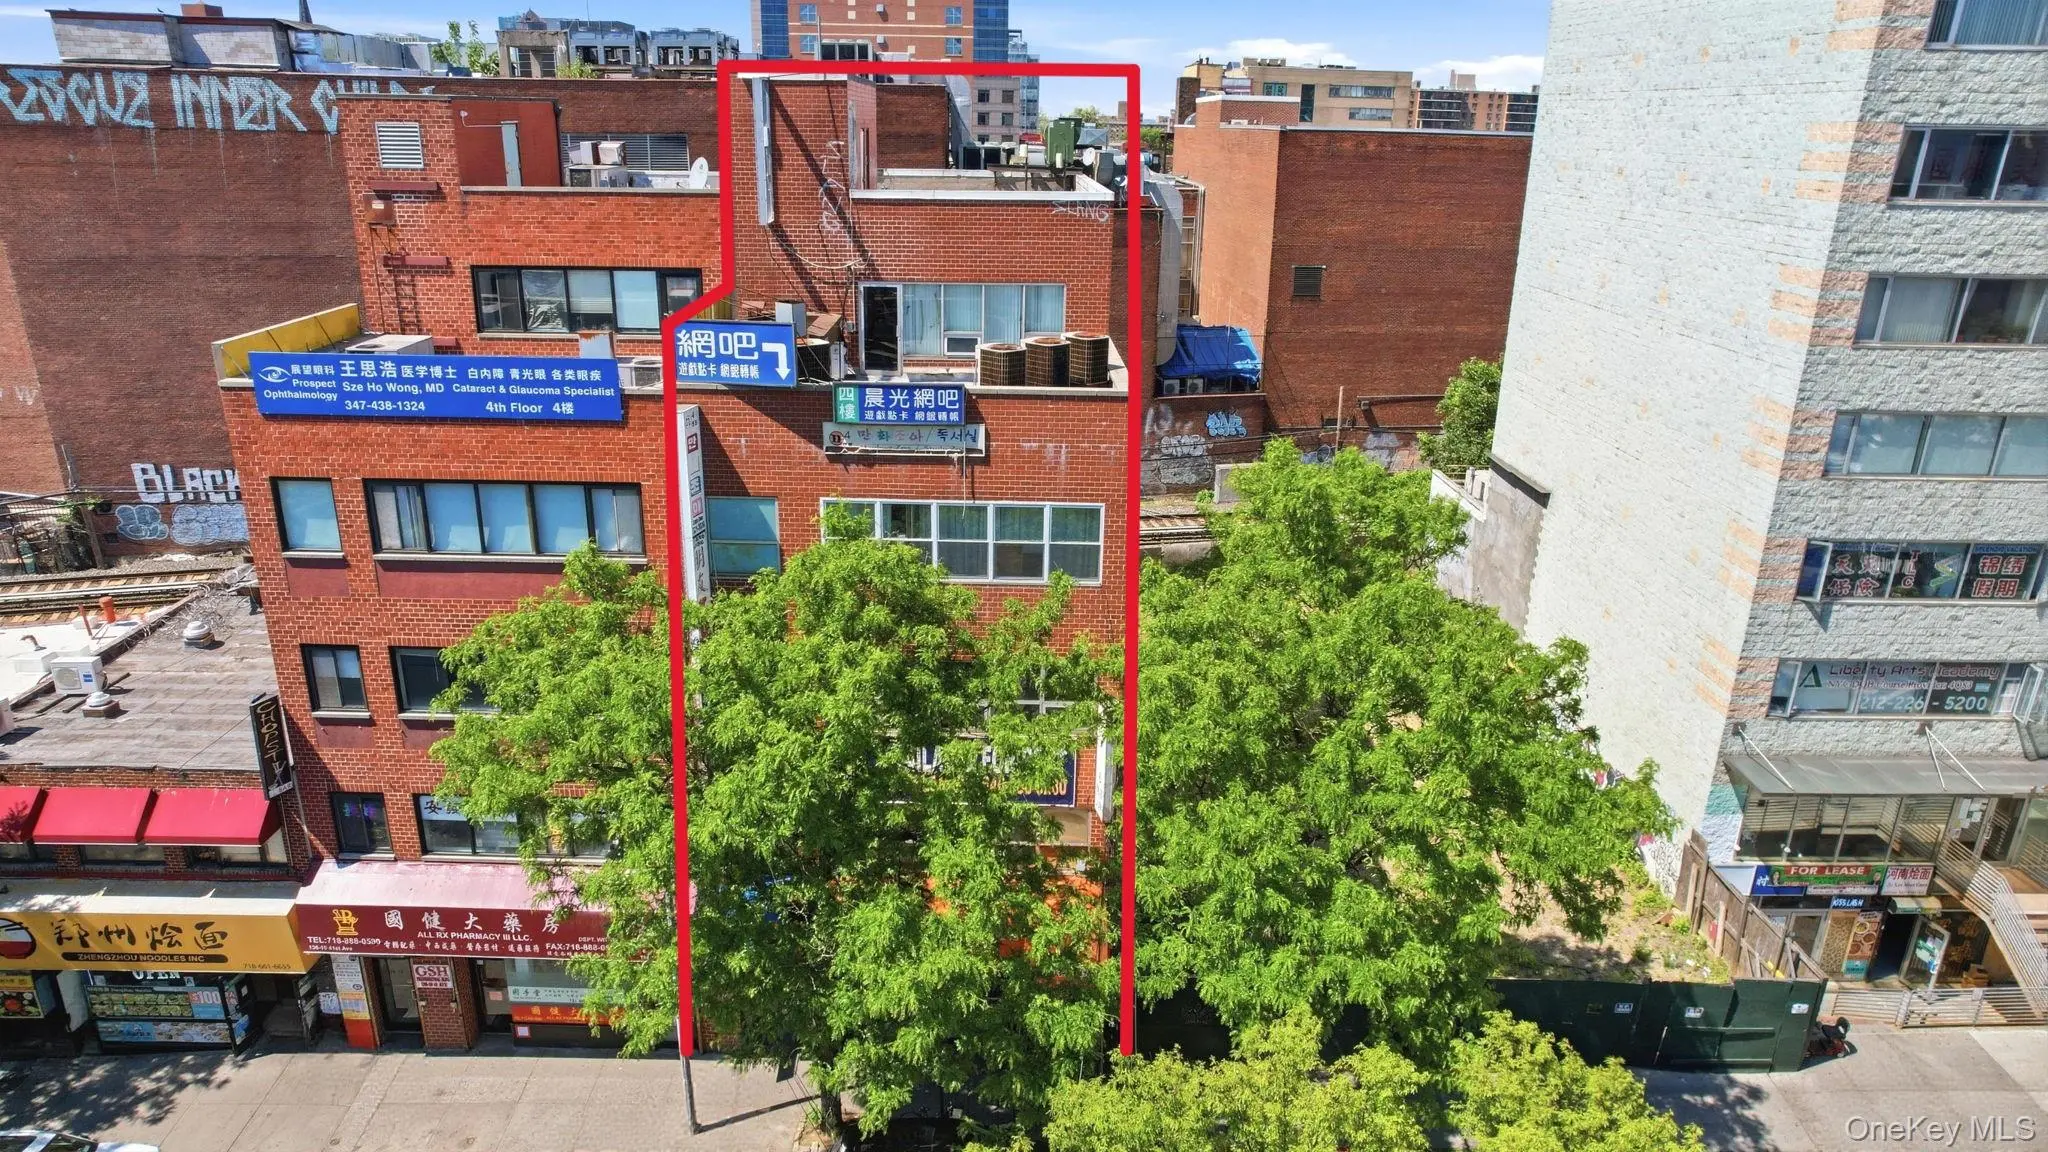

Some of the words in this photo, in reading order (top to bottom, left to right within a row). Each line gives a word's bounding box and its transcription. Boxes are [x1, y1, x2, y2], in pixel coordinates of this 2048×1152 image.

[676, 329, 759, 360] 網吧
[290, 364, 335, 376] 展望眼科
[339, 360, 397, 378] 王思浩
[401, 365, 457, 379] 医学博士
[468, 368, 504, 380] 白内障
[509, 368, 546, 380] 青光眼
[551, 369, 602, 381] 各类眼疾
[292, 379, 336, 389] Prospect
[342, 382, 364, 392] Sze
[367, 383, 383, 392] Ho
[385, 383, 423, 395] Wong,
[425, 384, 445, 393] MD
[452, 384, 496, 394] Cataract
[499, 385, 506, 394] &
[509, 386, 560, 395] Glaucoma
[563, 387, 615, 397] Specialist
[263, 390, 338, 402] Ophthalmology
[864, 387, 960, 409] 晨光網吧
[344, 400, 426, 411] 347-438-1324
[485, 401, 507, 413] 4th
[510, 402, 543, 414] Floor
[552, 402, 574, 415] 4楼
[838, 387, 856, 420] 四樓
[1971, 578, 2019, 598] 假期
[1891, 665, 1927, 676] Arts
[1861, 696, 1925, 710] 212-226
[1944, 696, 1988, 710] 5200
[1790, 867, 1818, 875] FOR
[1824, 866, 1865, 875] LEASE
[384, 909, 559, 934] 國健大藥房
[50, 917, 228, 950] 郑州烩面
[417, 931, 435, 939] ALL
[450, 932, 500, 940] PHARMACY
[77, 952, 137, 961] ZHENGZHOU
[139, 953, 187, 962] NOODLES
[415, 965, 449, 977] GSH
